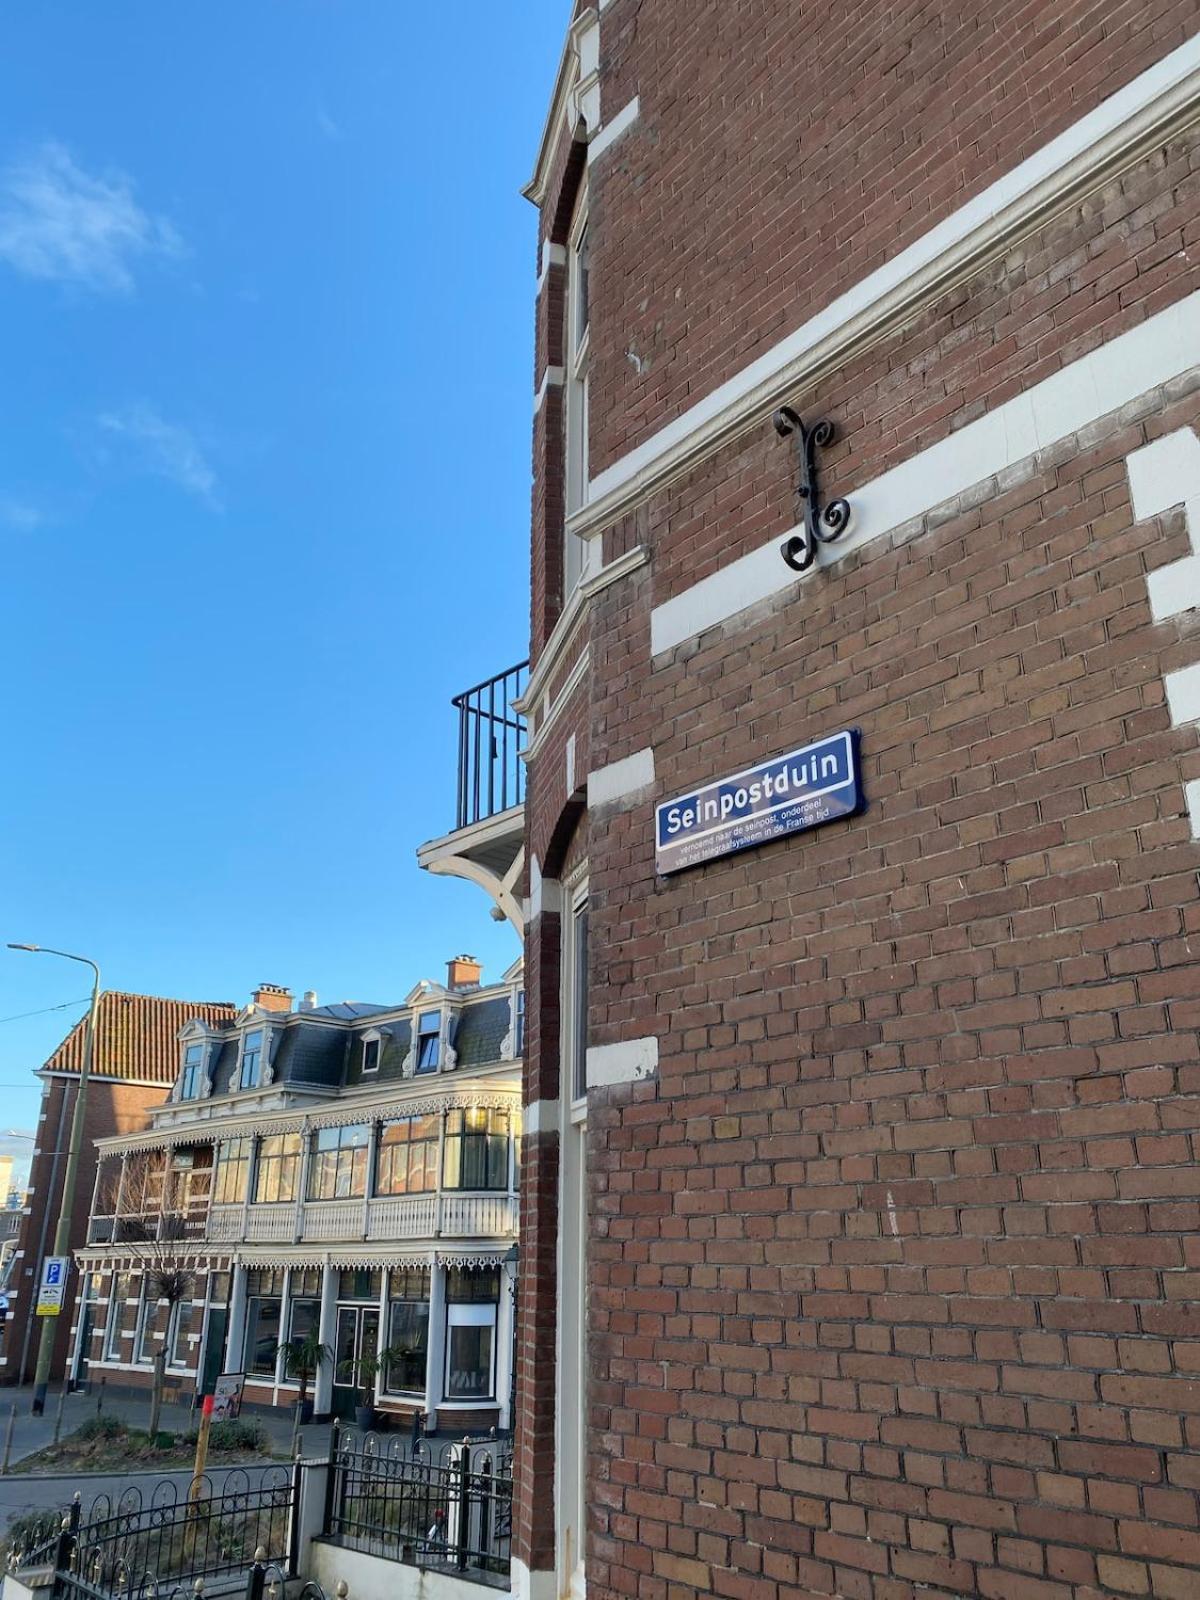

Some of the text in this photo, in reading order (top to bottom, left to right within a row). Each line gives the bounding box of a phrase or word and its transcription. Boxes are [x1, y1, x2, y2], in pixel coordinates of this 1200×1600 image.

[666, 752, 838, 834] Seinpostduin
[675, 856, 688, 866] van
[689, 852, 700, 862] het
[764, 828, 772, 837] in
[774, 824, 784, 834] de
[786, 813, 814, 830] Franse
[816, 808, 830, 821] tijd
[680, 835, 714, 854] vernoemd
[715, 831, 732, 842] naar
[733, 826, 743, 836] de
[781, 798, 822, 820] onderdeel
[50, 1265, 58, 1275] P
